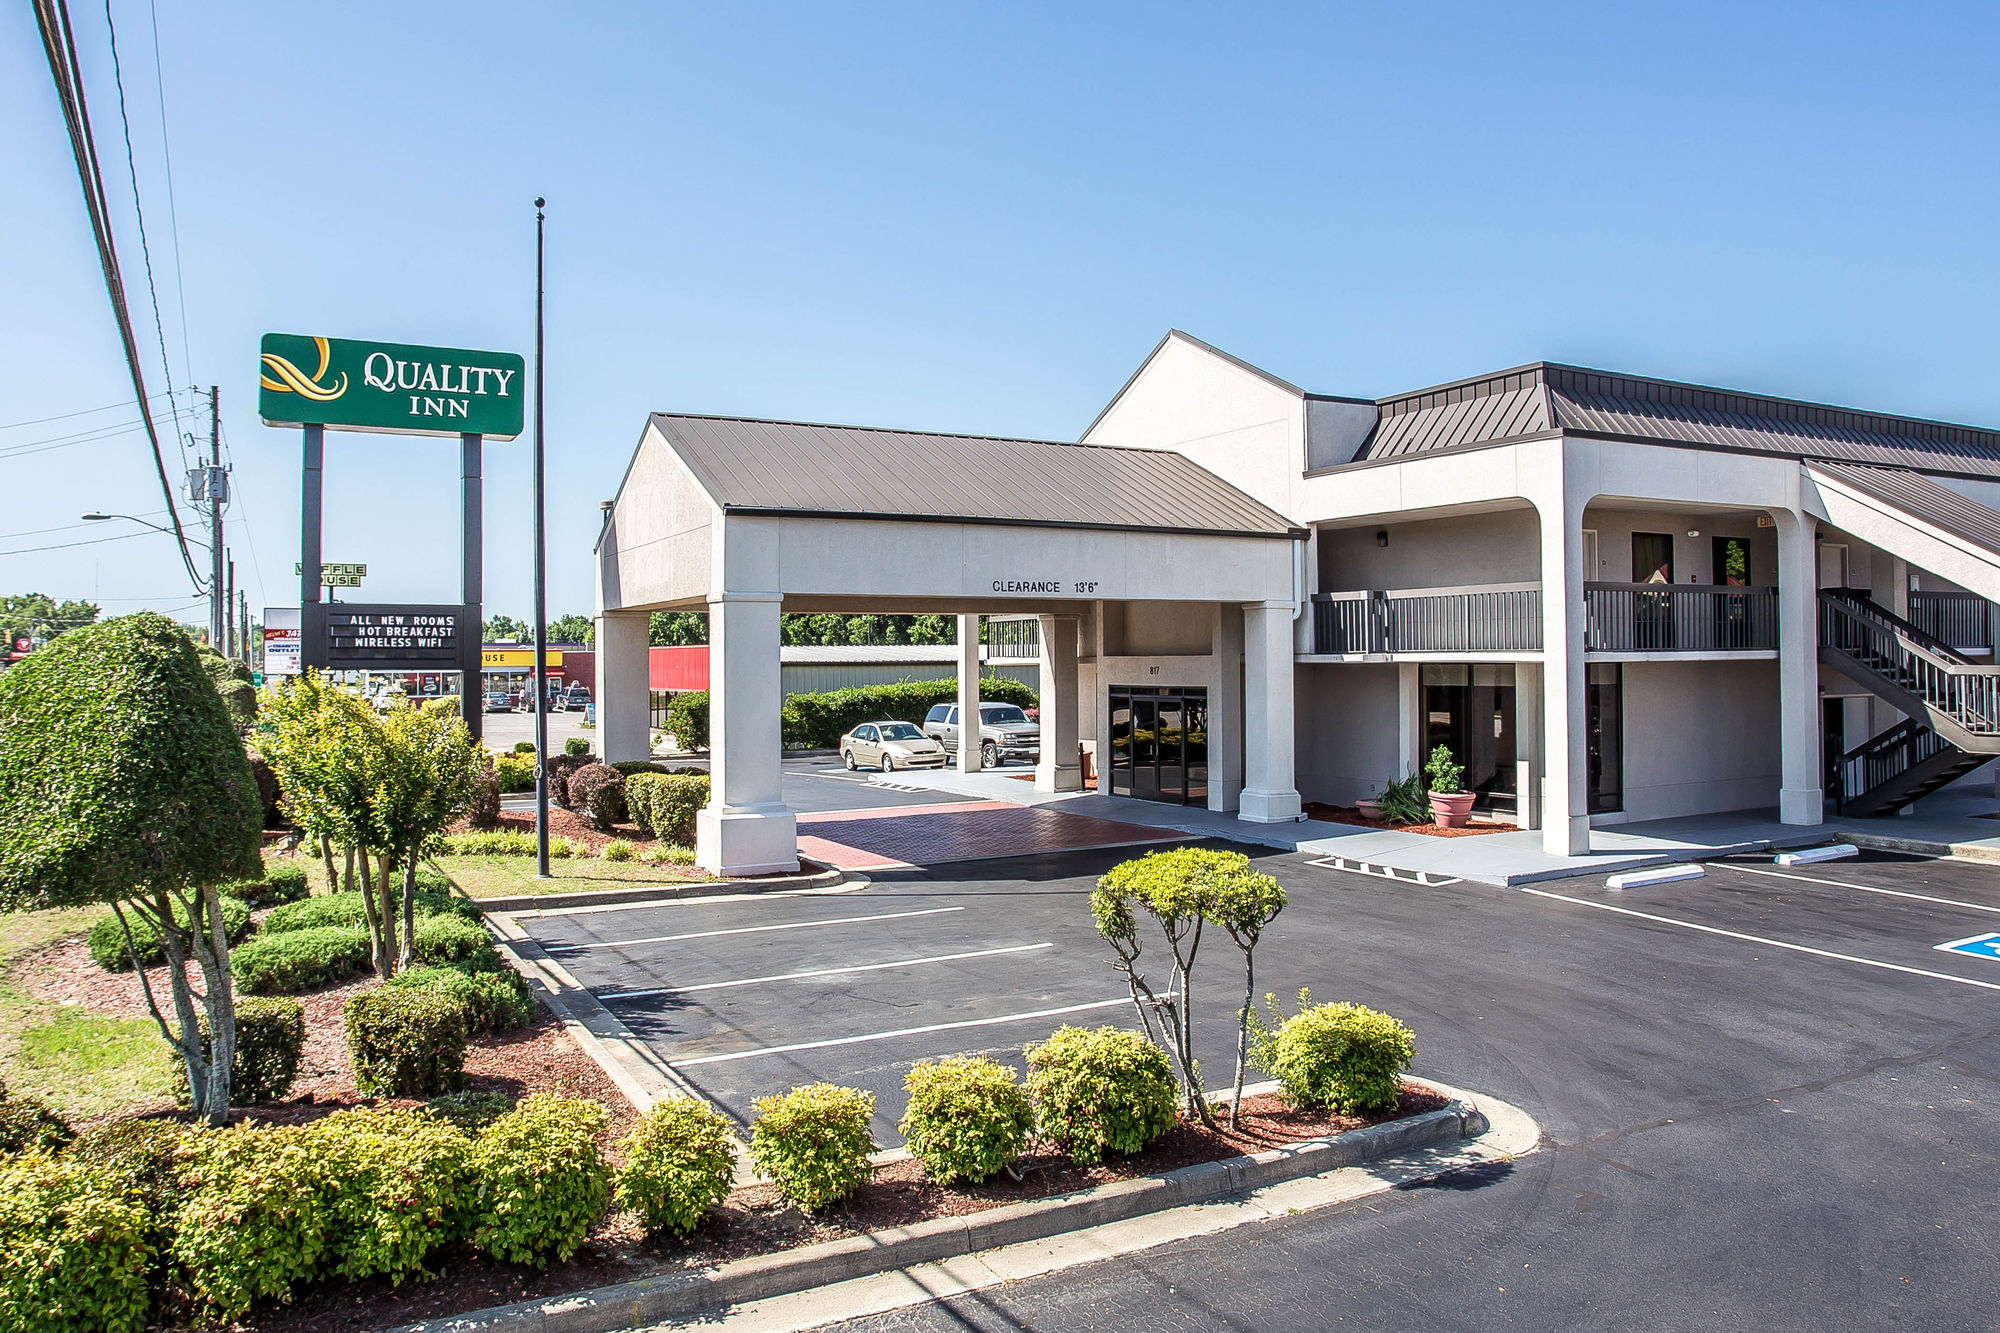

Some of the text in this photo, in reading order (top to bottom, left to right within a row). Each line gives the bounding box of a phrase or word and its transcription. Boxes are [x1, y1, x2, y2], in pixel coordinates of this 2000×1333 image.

[364, 352, 515, 396] QUALITY
[409, 396, 469, 418] INN
[992, 580, 1098, 593] CLEARANCE 13'6"
[350, 615, 454, 626] ALL NEW ROOMS
[359, 626, 453, 637] HOT BREAKFAST
[355, 637, 442, 648] WIRELESS WIFI
[1150, 666, 1160, 675] 817
